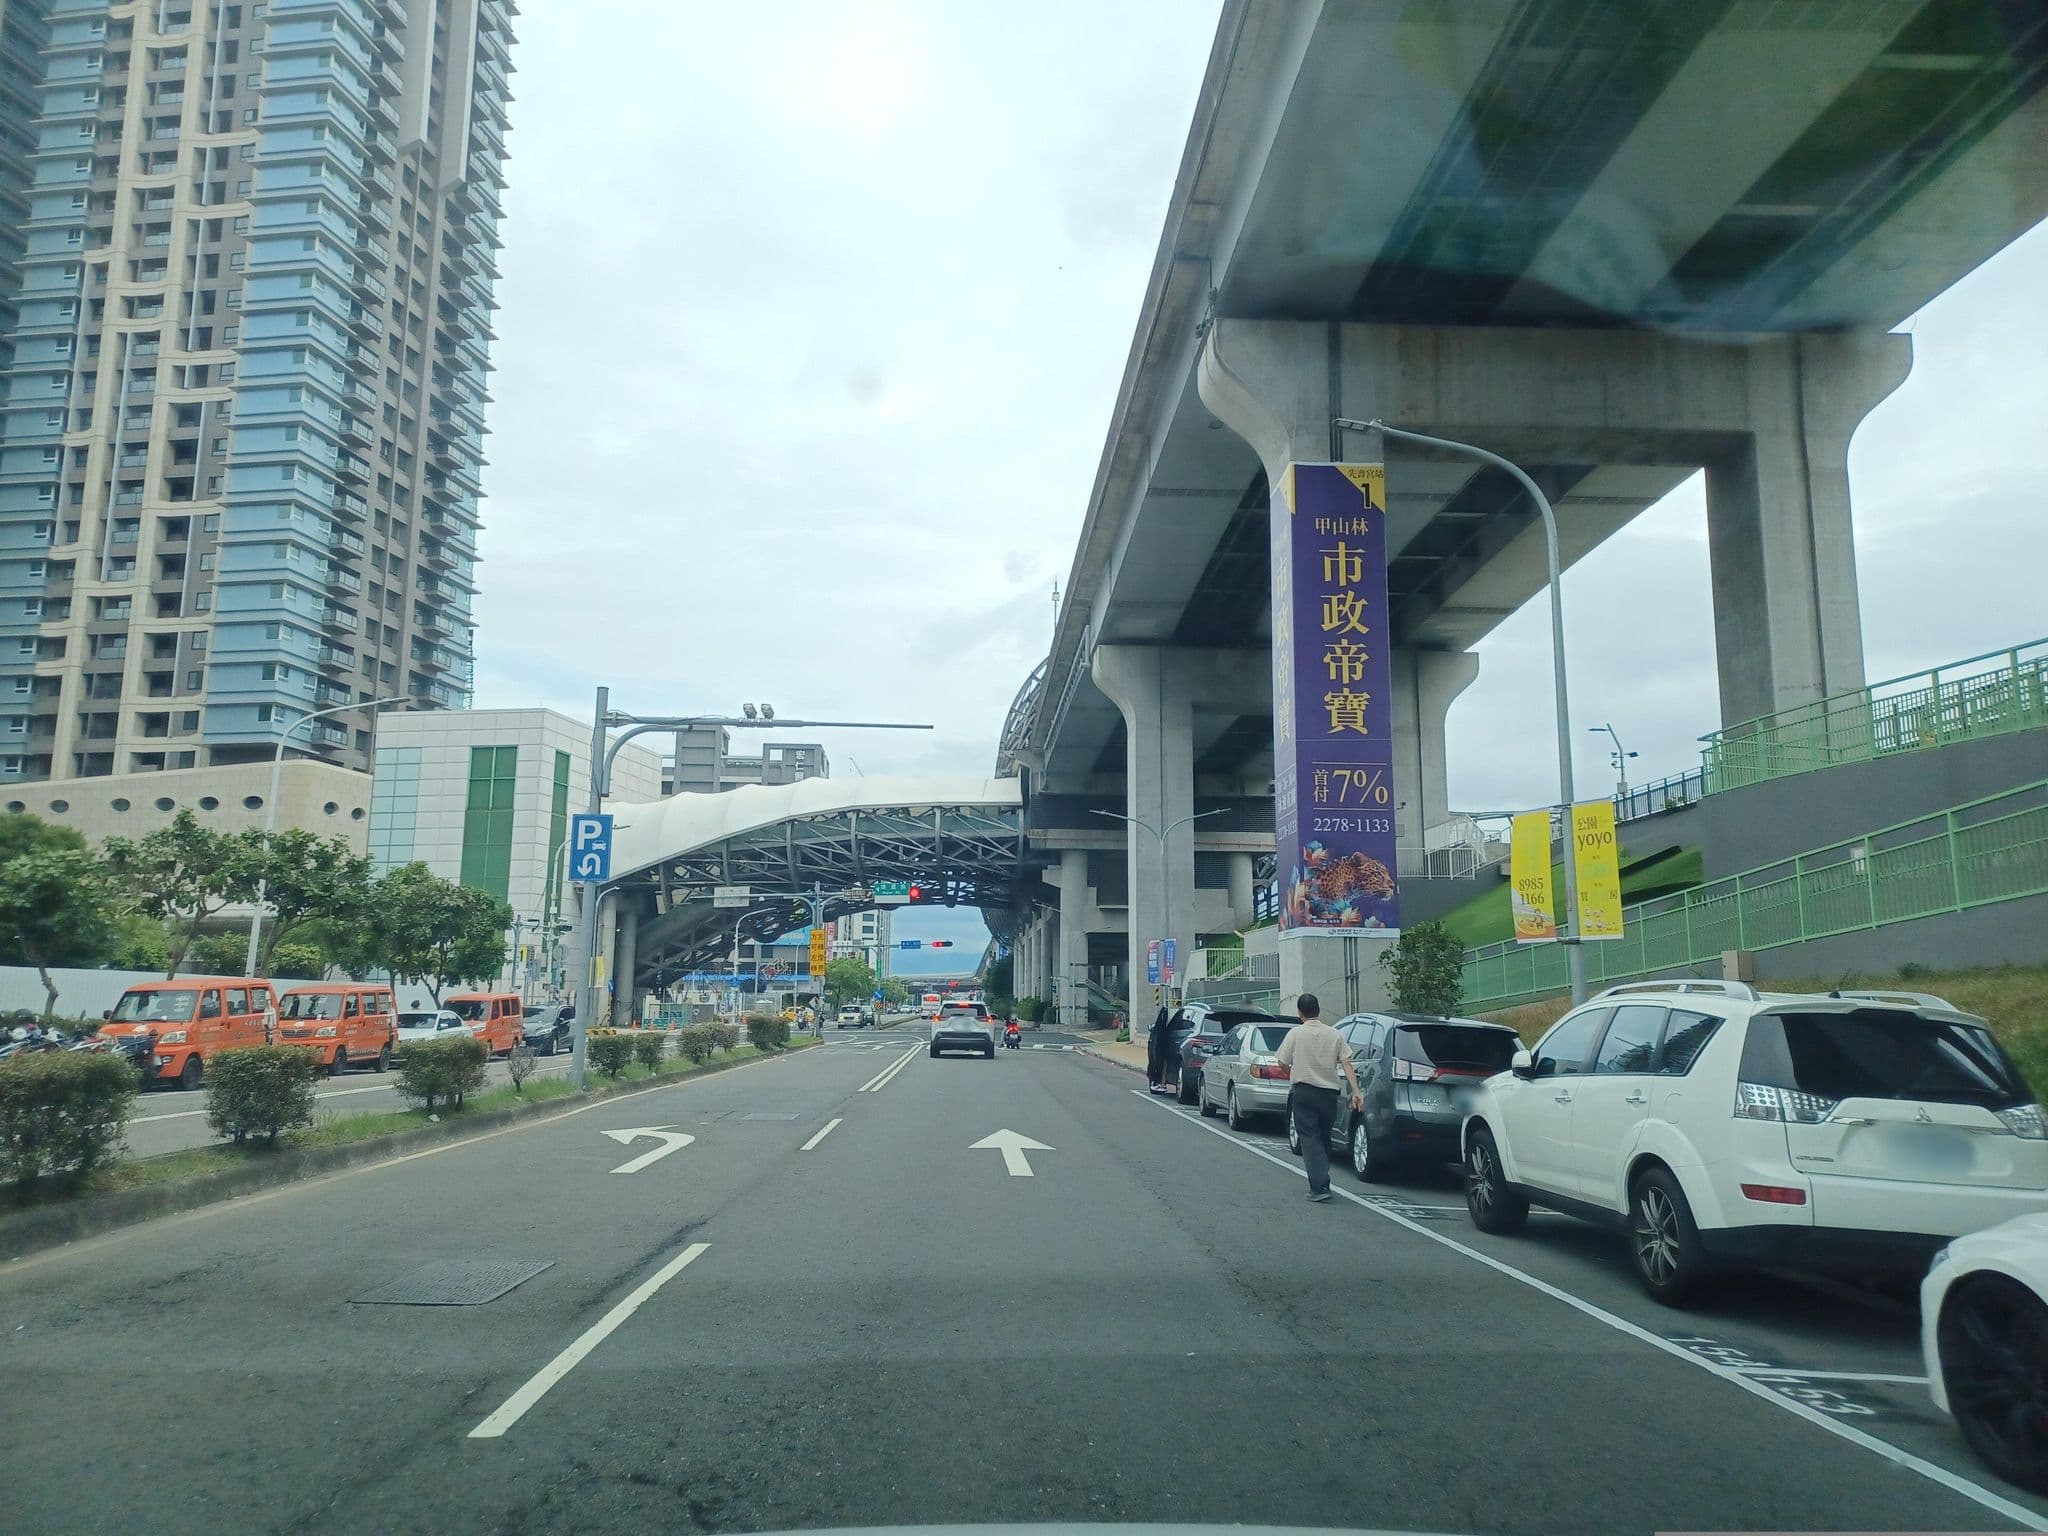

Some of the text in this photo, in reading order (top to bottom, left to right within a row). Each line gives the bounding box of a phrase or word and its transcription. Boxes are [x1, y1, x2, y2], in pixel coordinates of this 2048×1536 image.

[1361, 483, 1372, 510] 1
[1315, 517, 1369, 537] 甲山林
[1320, 541, 1371, 735] 市政帝寶
[1312, 769, 1329, 803] 首付
[1332, 769, 1389, 804] 7%
[577, 820, 602, 850] P
[1313, 818, 1390, 833] 2278-1133
[1577, 831, 1612, 852] yoyo
[1519, 878, 1544, 891] 8985
[1520, 893, 1545, 906] 1166
